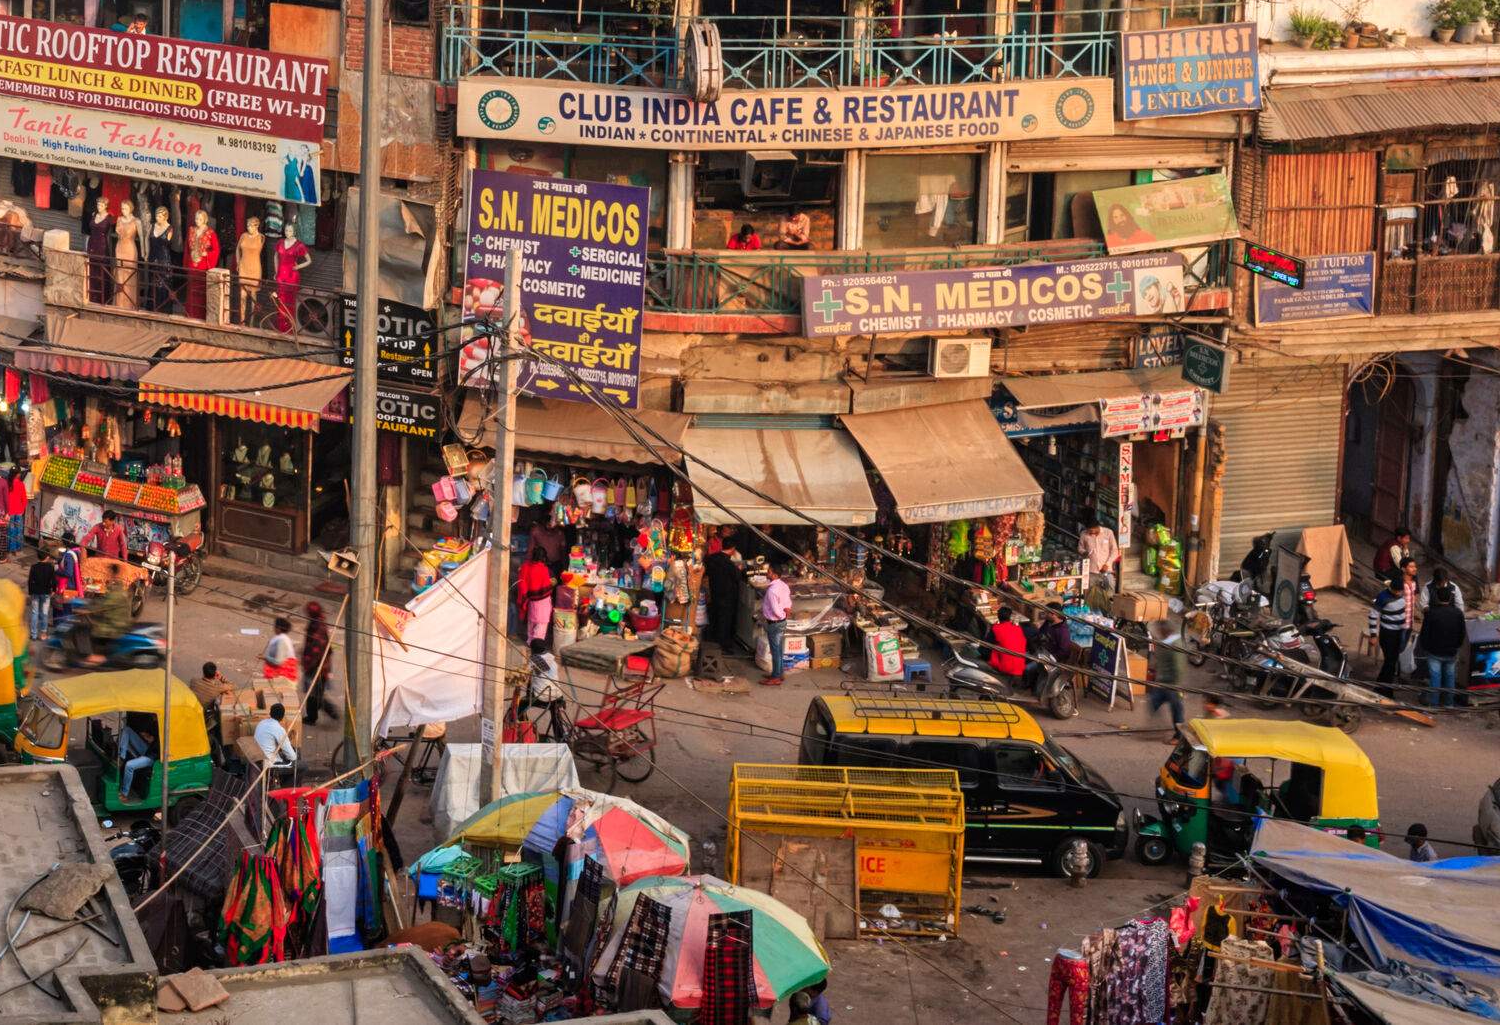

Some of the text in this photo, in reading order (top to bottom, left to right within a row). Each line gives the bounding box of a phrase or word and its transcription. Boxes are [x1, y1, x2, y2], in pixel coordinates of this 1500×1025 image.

[1128, 28, 1251, 61] BREAKFAST
[36, 26, 151, 71] ROOFTOP
[157, 42, 328, 96] RESTAURANT
[1129, 57, 1253, 87] LUNCH & DINNER
[48, 66, 107, 89] LUNCH
[111, 75, 123, 90] &
[129, 77, 198, 102] DINNER
[59, 88, 73, 101] US
[77, 90, 102, 105] FOR
[104, 94, 171, 116] DELICIOUS
[173, 103, 208, 121] FOOD
[211, 110, 272, 131] SERVICES
[207, 87, 326, 125] (FREE WI-FI)
[559, 89, 1019, 125] CLUB INDIA CAFE & RESTAURANT
[1147, 87, 1239, 111] ENTRANCE
[7, 106, 203, 156] Tanika Fashion
[579, 122, 999, 143] INDIAN CONTINENTAL CHINESE & JAPANESE FOOD
[228, 138, 277, 154] 9810183192
[42, 139, 263, 181] High Fashion Sequins Garments Belly Dance Dresses
[533, 180, 573, 193] जय माता
[479, 188, 640, 246] S.N. MEDICOS
[486, 236, 540, 255] CHEMIST
[582, 247, 643, 267] SERGICAL
[580, 265, 641, 285] MEDICINE
[1121, 257, 1168, 269] 8010187917
[1322, 256, 1365, 269] TUITION
[522, 278, 586, 299] COSMETIC
[843, 275, 898, 287] 9205564621
[845, 272, 1103, 315] S.N. MEDICOS
[859, 304, 1093, 333] CHEMIST PHARMACY COSMETIC
[411, 368, 433, 378] OPEN
